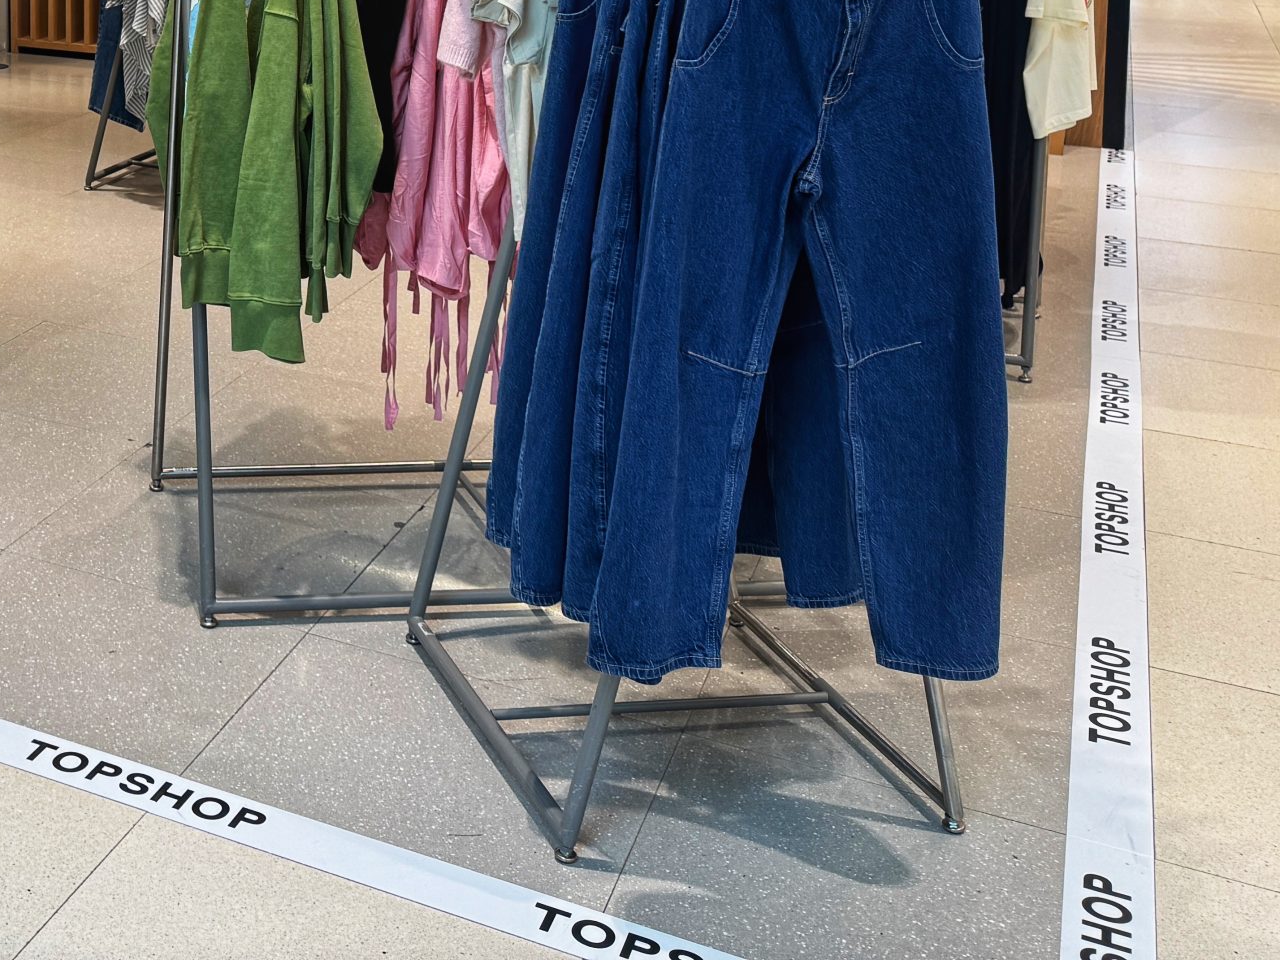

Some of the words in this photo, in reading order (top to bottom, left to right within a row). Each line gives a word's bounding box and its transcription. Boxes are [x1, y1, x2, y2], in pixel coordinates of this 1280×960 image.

[1101, 299, 1127, 342] TOPSHOP
[1099, 372, 1130, 425] TOPSHOP
[1094, 481, 1130, 556] TOPSHOP
[1088, 636, 1132, 746] TOPSHOP
[24, 738, 268, 831] TOPSHOP
